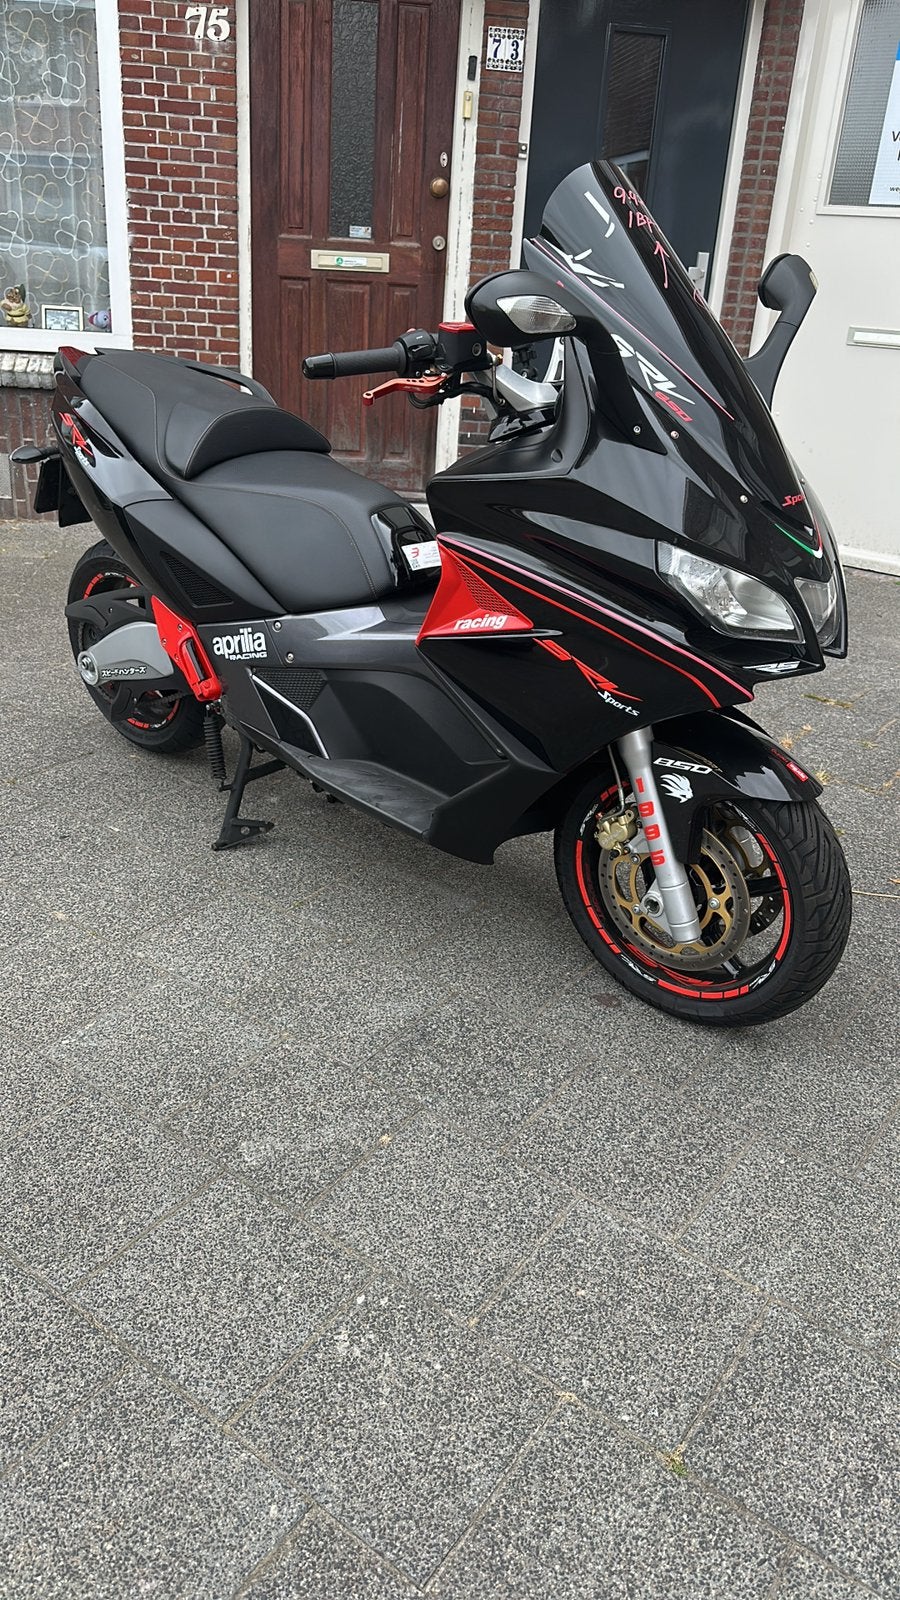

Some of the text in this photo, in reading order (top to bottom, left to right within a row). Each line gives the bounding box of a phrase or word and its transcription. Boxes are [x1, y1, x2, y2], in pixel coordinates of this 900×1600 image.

[184, 6, 230, 42] 75
[453, 613, 508, 631] racing
[212, 627, 267, 659] aprilia
[229, 651, 268, 661] RACING
[597, 690, 640, 716] Sports
